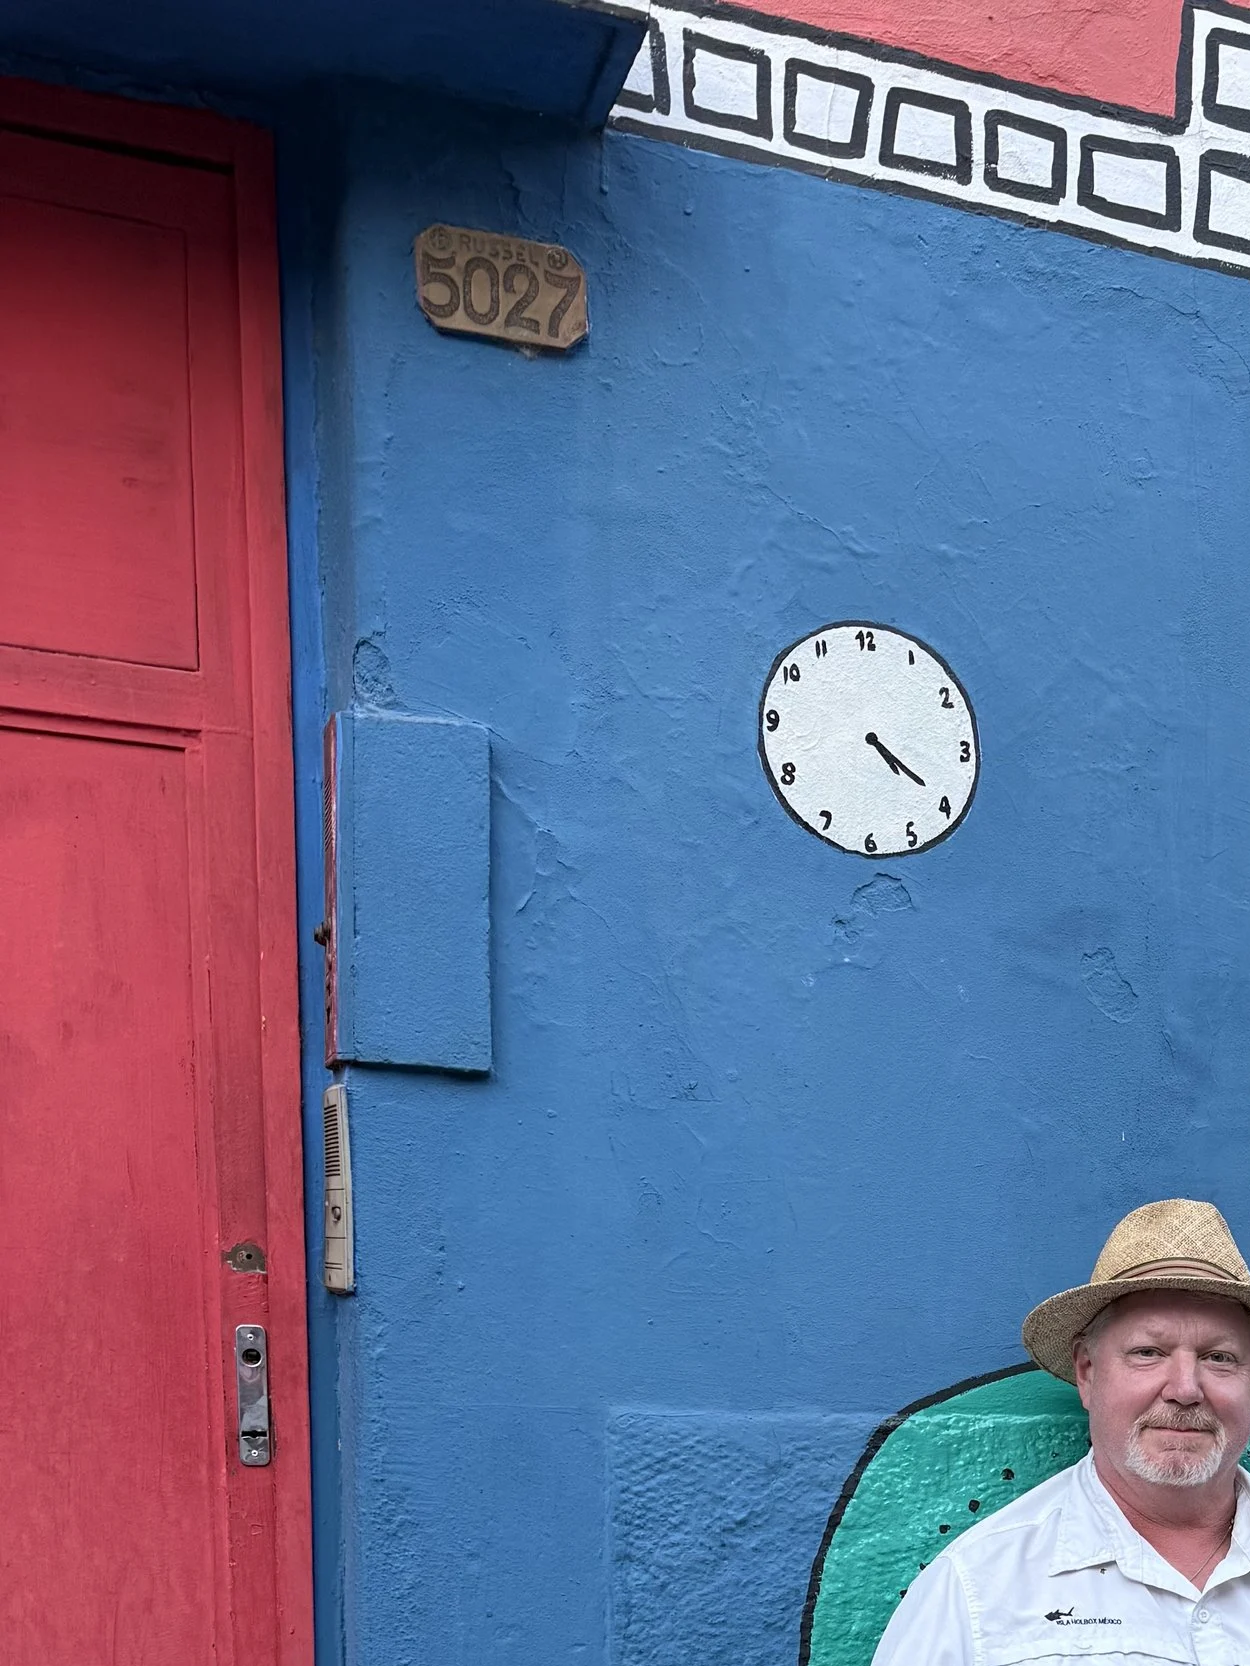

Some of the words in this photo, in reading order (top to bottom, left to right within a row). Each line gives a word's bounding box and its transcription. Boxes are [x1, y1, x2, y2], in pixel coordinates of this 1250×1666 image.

[421, 251, 582, 339] 5027
[815, 640, 828, 659] 11
[855, 630, 876, 651] 12
[908, 650, 915, 665] 1
[783, 663, 800, 684] 10
[939, 687, 954, 708] 2
[766, 709, 780, 732] 9
[959, 741, 971, 763] 3
[780, 762, 796, 785] 8
[938, 796, 951, 819] 4
[819, 810, 832, 830] 7
[864, 833, 877, 852] 6
[906, 821, 918, 847] 5
